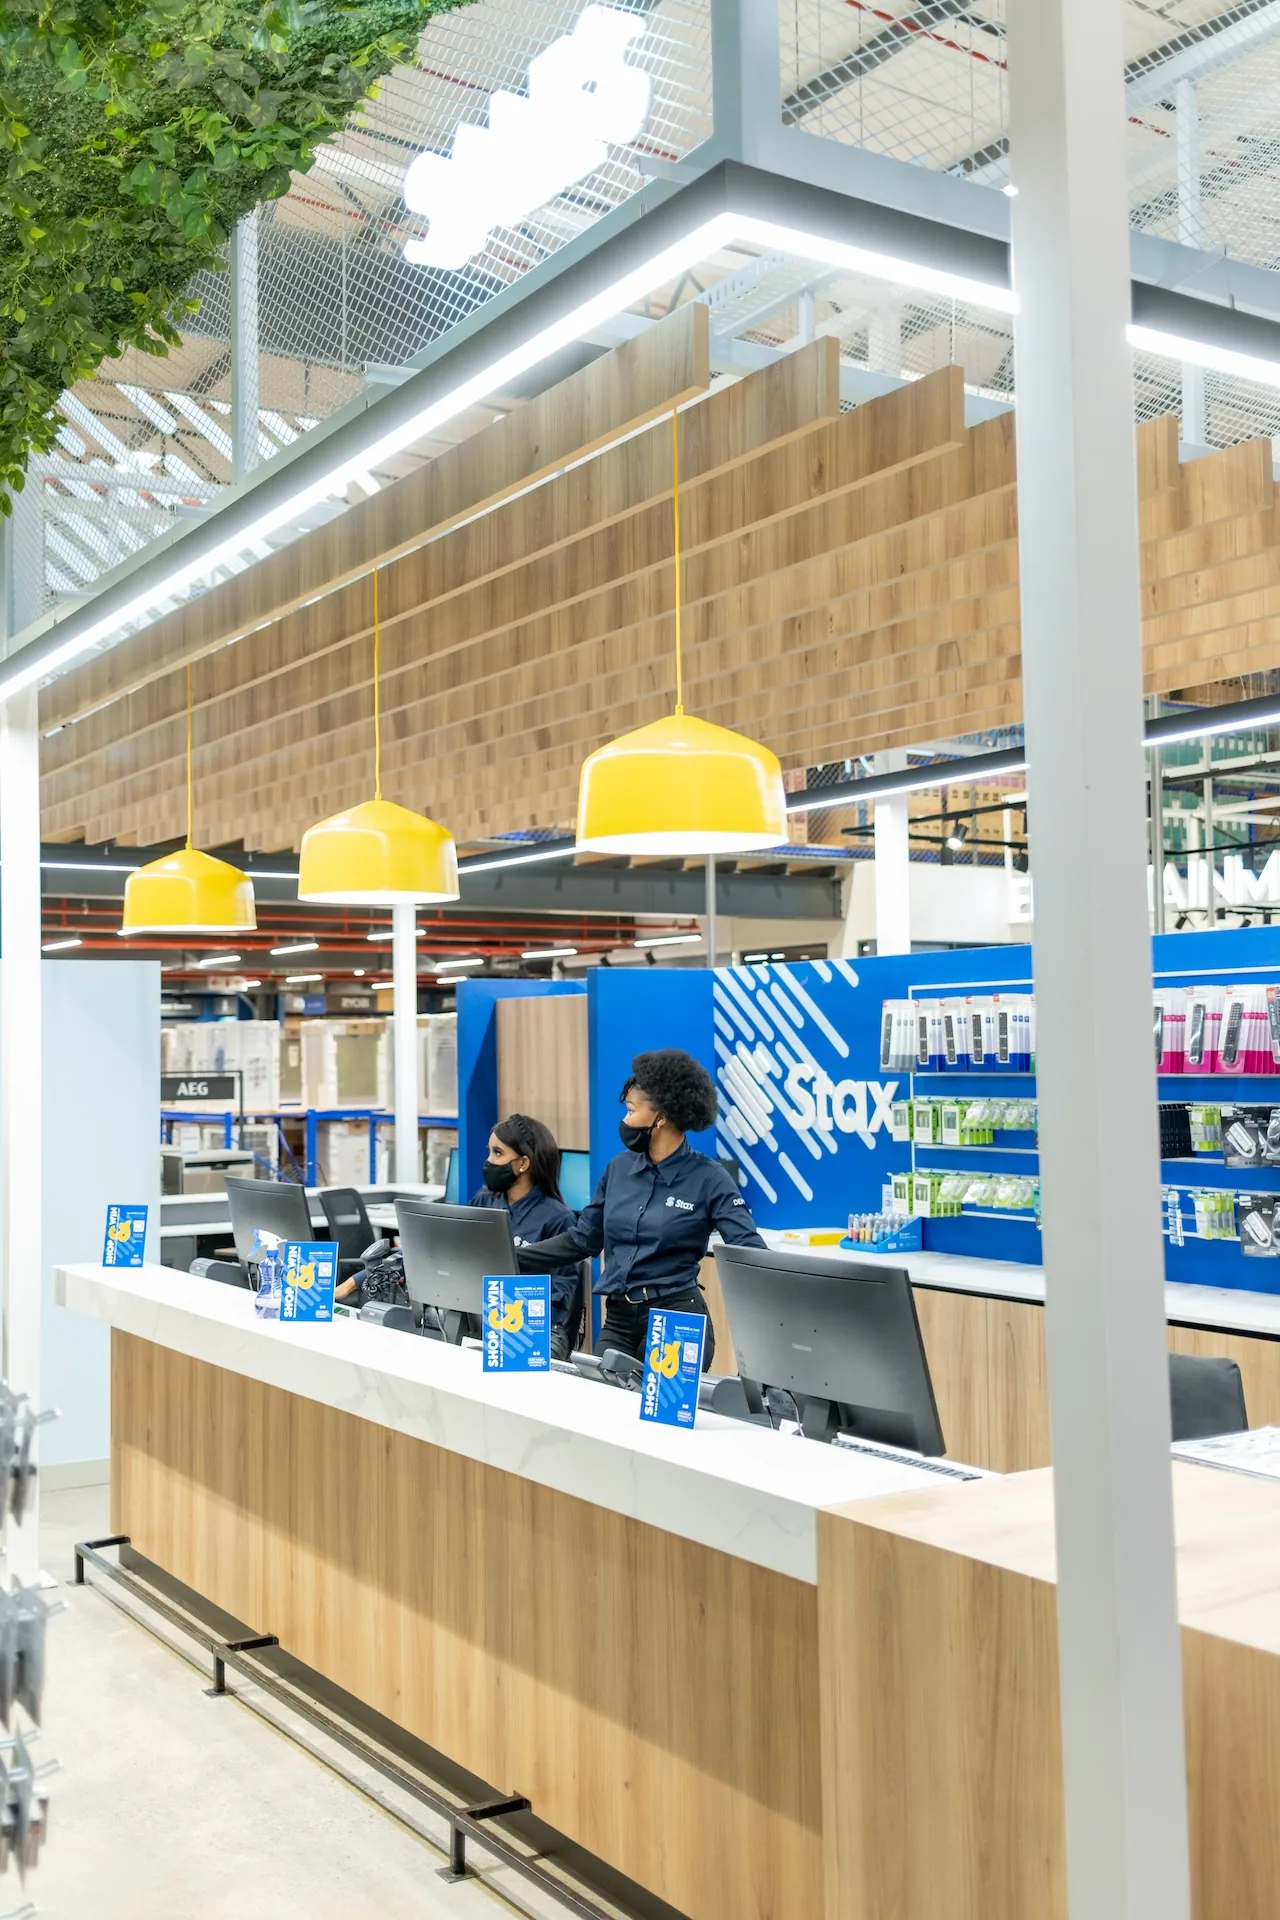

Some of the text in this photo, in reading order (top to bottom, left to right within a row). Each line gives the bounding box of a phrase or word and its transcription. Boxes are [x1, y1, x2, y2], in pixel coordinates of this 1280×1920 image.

[176, 1081, 209, 1096] AEG
[784, 1063, 900, 1134] Stax
[109, 1206, 119, 1226] WIN
[674, 1198, 695, 1211] Stax
[105, 1239, 116, 1264] SHOP
[287, 1245, 298, 1268] WIN
[284, 1286, 295, 1318] SHOP
[487, 1280, 500, 1308] WIN
[650, 1314, 664, 1346] WIN
[487, 1330, 500, 1368] SHOP
[644, 1372, 658, 1415] SHOP
